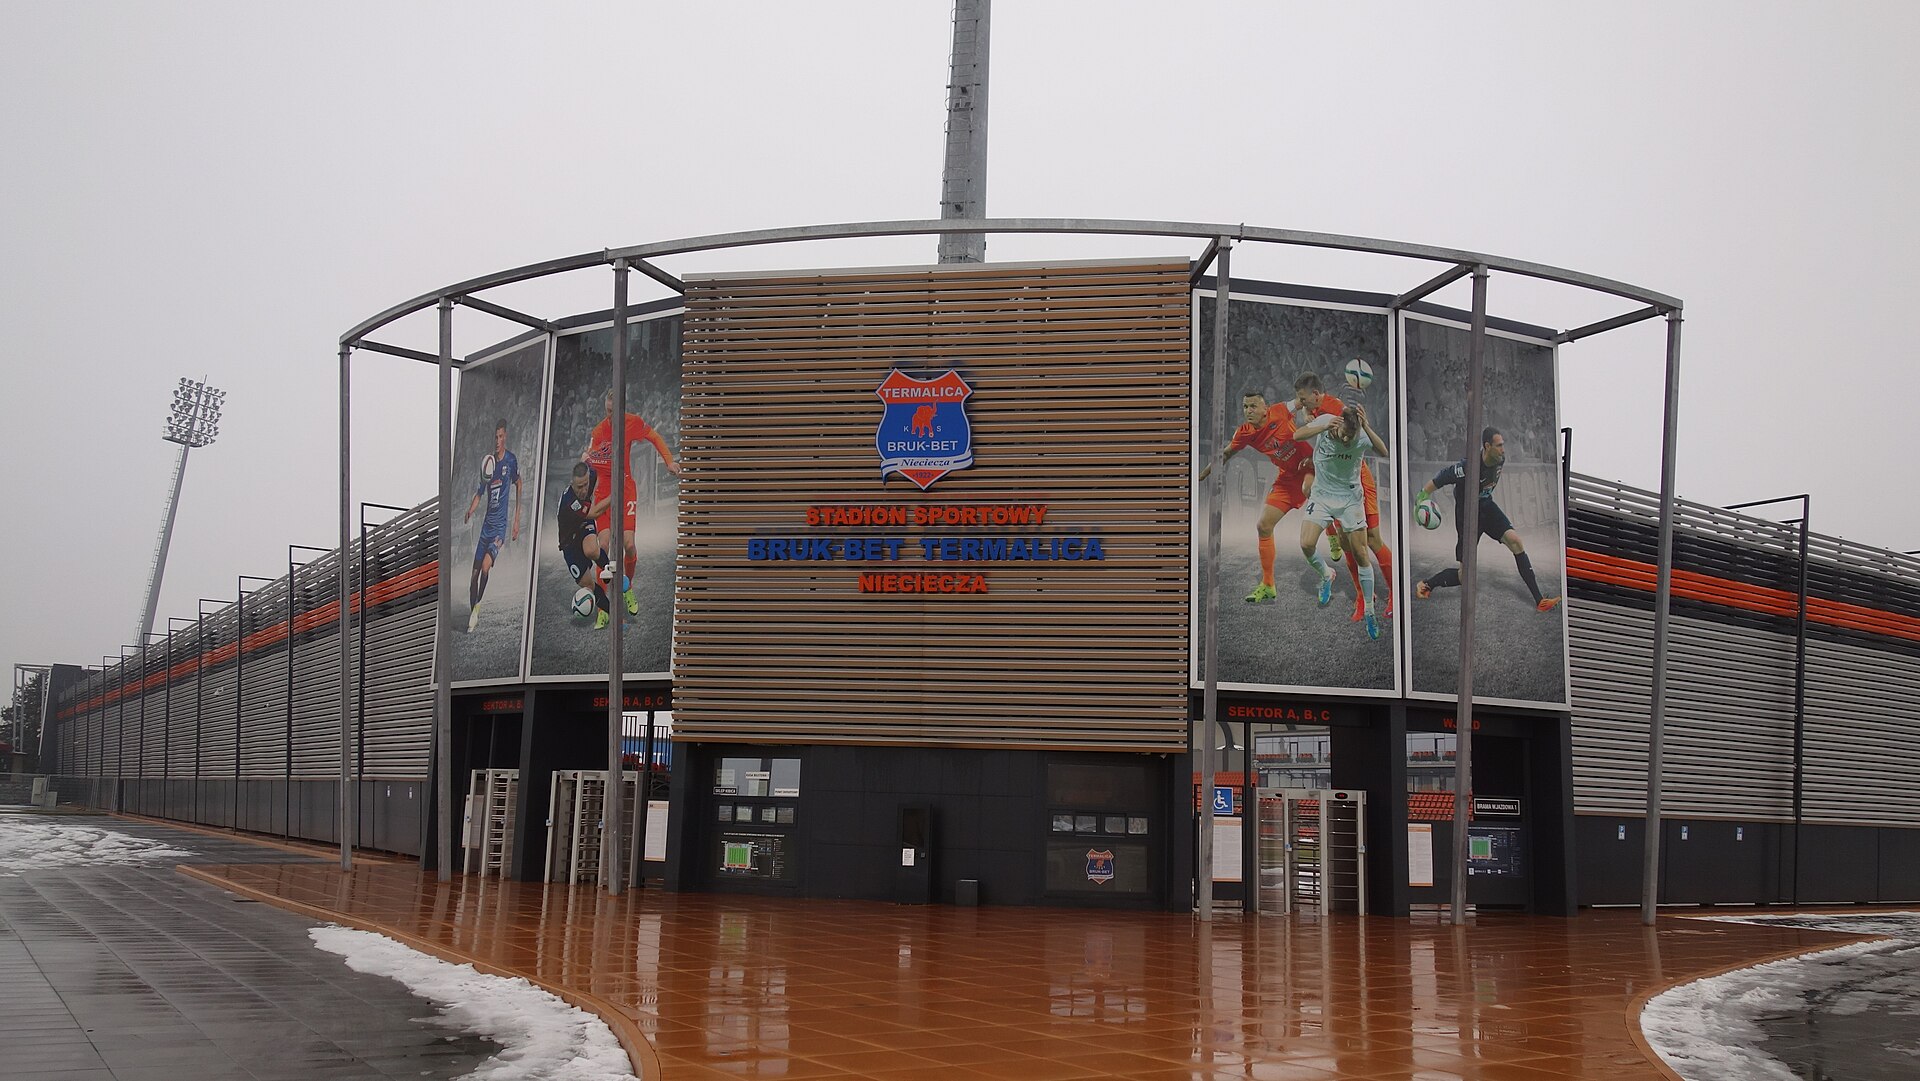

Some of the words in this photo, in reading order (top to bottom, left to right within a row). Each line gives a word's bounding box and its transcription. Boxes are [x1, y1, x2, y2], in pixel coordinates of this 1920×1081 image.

[882, 386, 964, 398] TERMALICA
[887, 441, 958, 452] BRUK-BET
[901, 459, 950, 467] Nieciecza
[806, 507, 907, 526] STADION
[914, 505, 1047, 525] SPORTOWY
[747, 538, 906, 561] BRUK-BET
[921, 537, 1105, 561] TERMALICA
[858, 573, 989, 593] NIECIECZA
[633, 697, 641, 707] A,
[656, 696, 663, 706] C
[1228, 706, 1282, 718] SEKTOR
[1287, 709, 1300, 721] A,
[1304, 709, 1317, 722] B,
[1321, 710, 1331, 721] C
